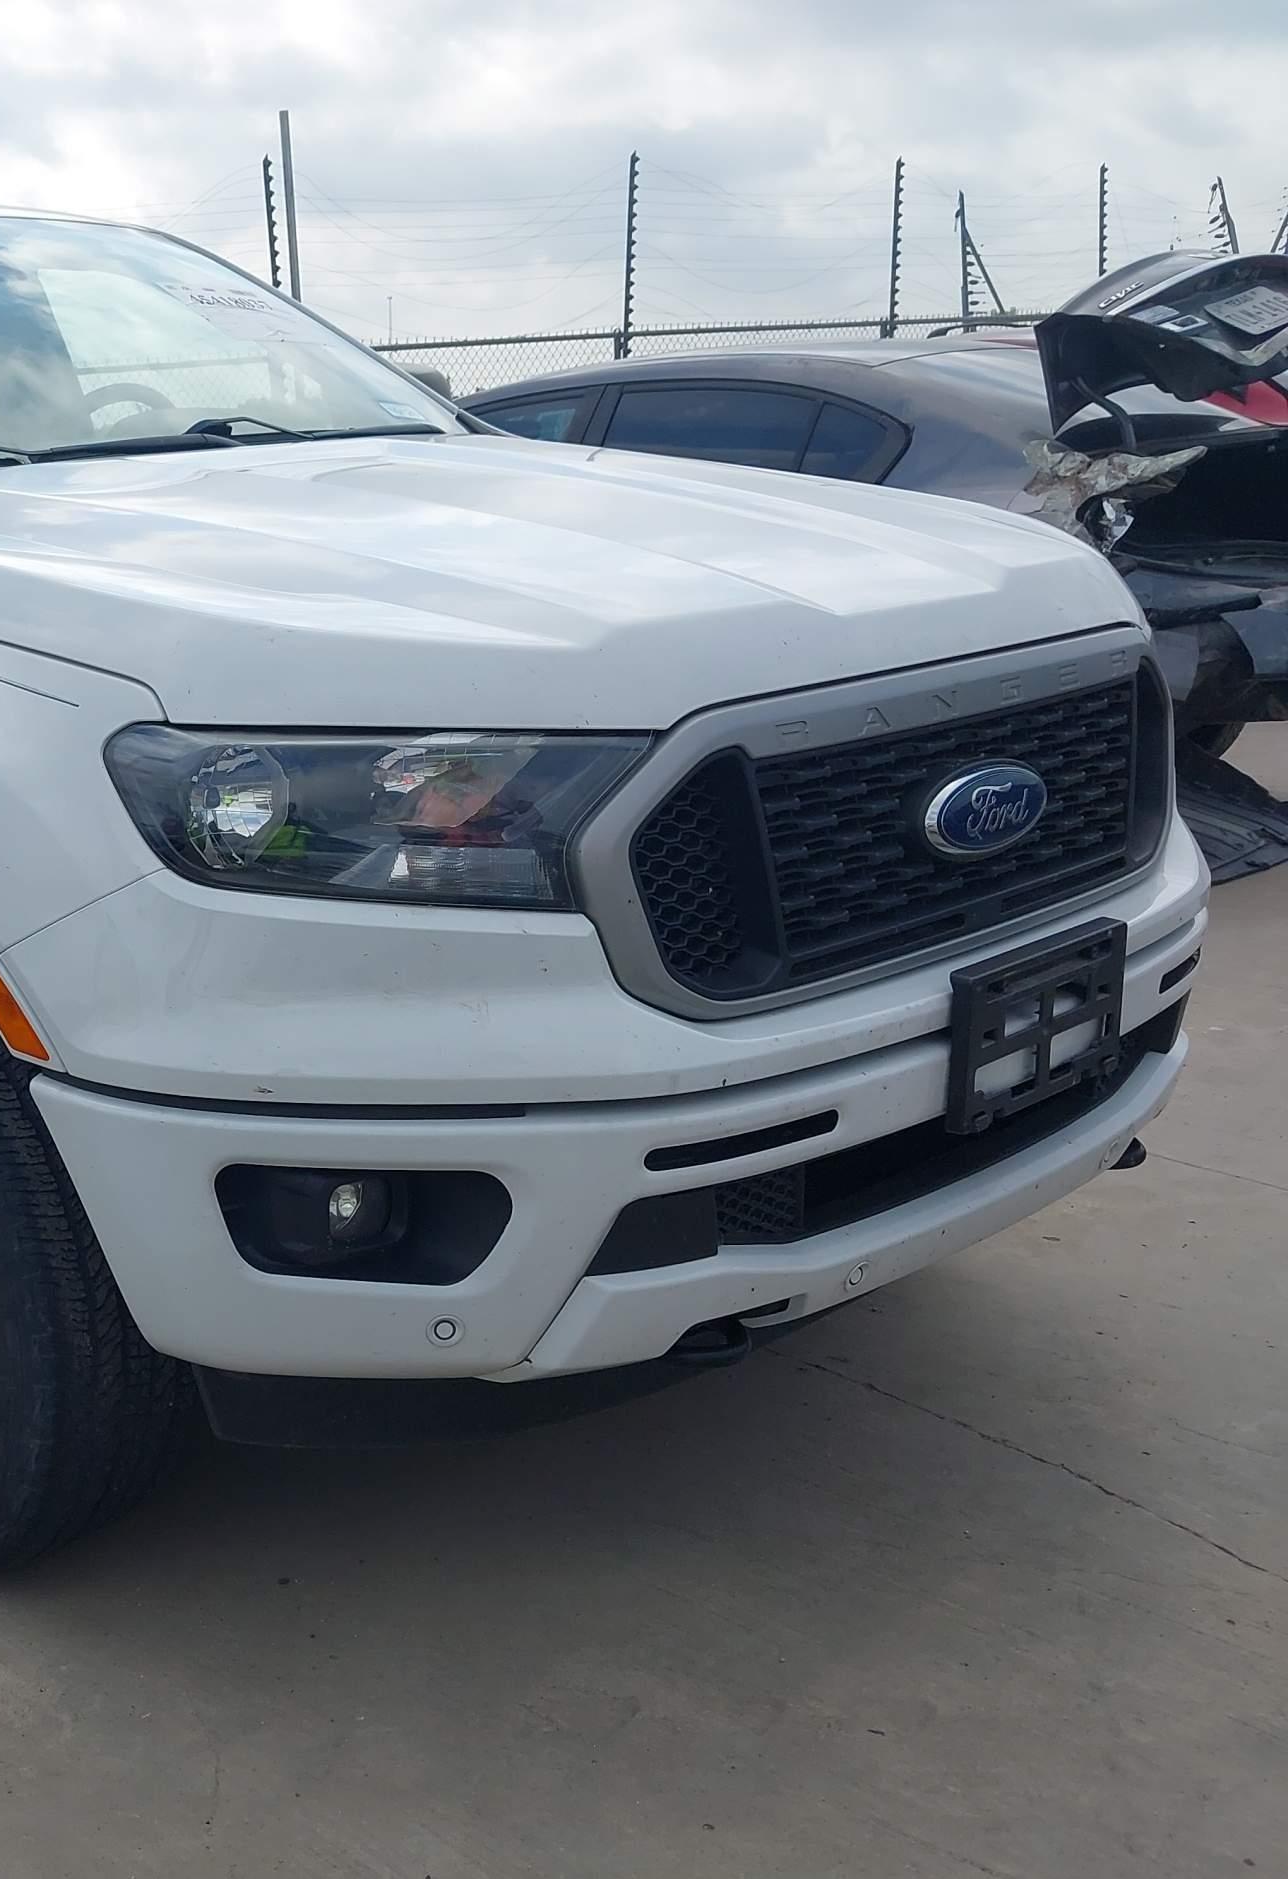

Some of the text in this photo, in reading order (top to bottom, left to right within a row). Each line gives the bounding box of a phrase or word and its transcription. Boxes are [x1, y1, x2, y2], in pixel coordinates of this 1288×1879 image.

[1099, 280, 1144, 308] CIVIC
[774, 649, 1129, 741] RANGER
[966, 781, 1029, 840] Ford
